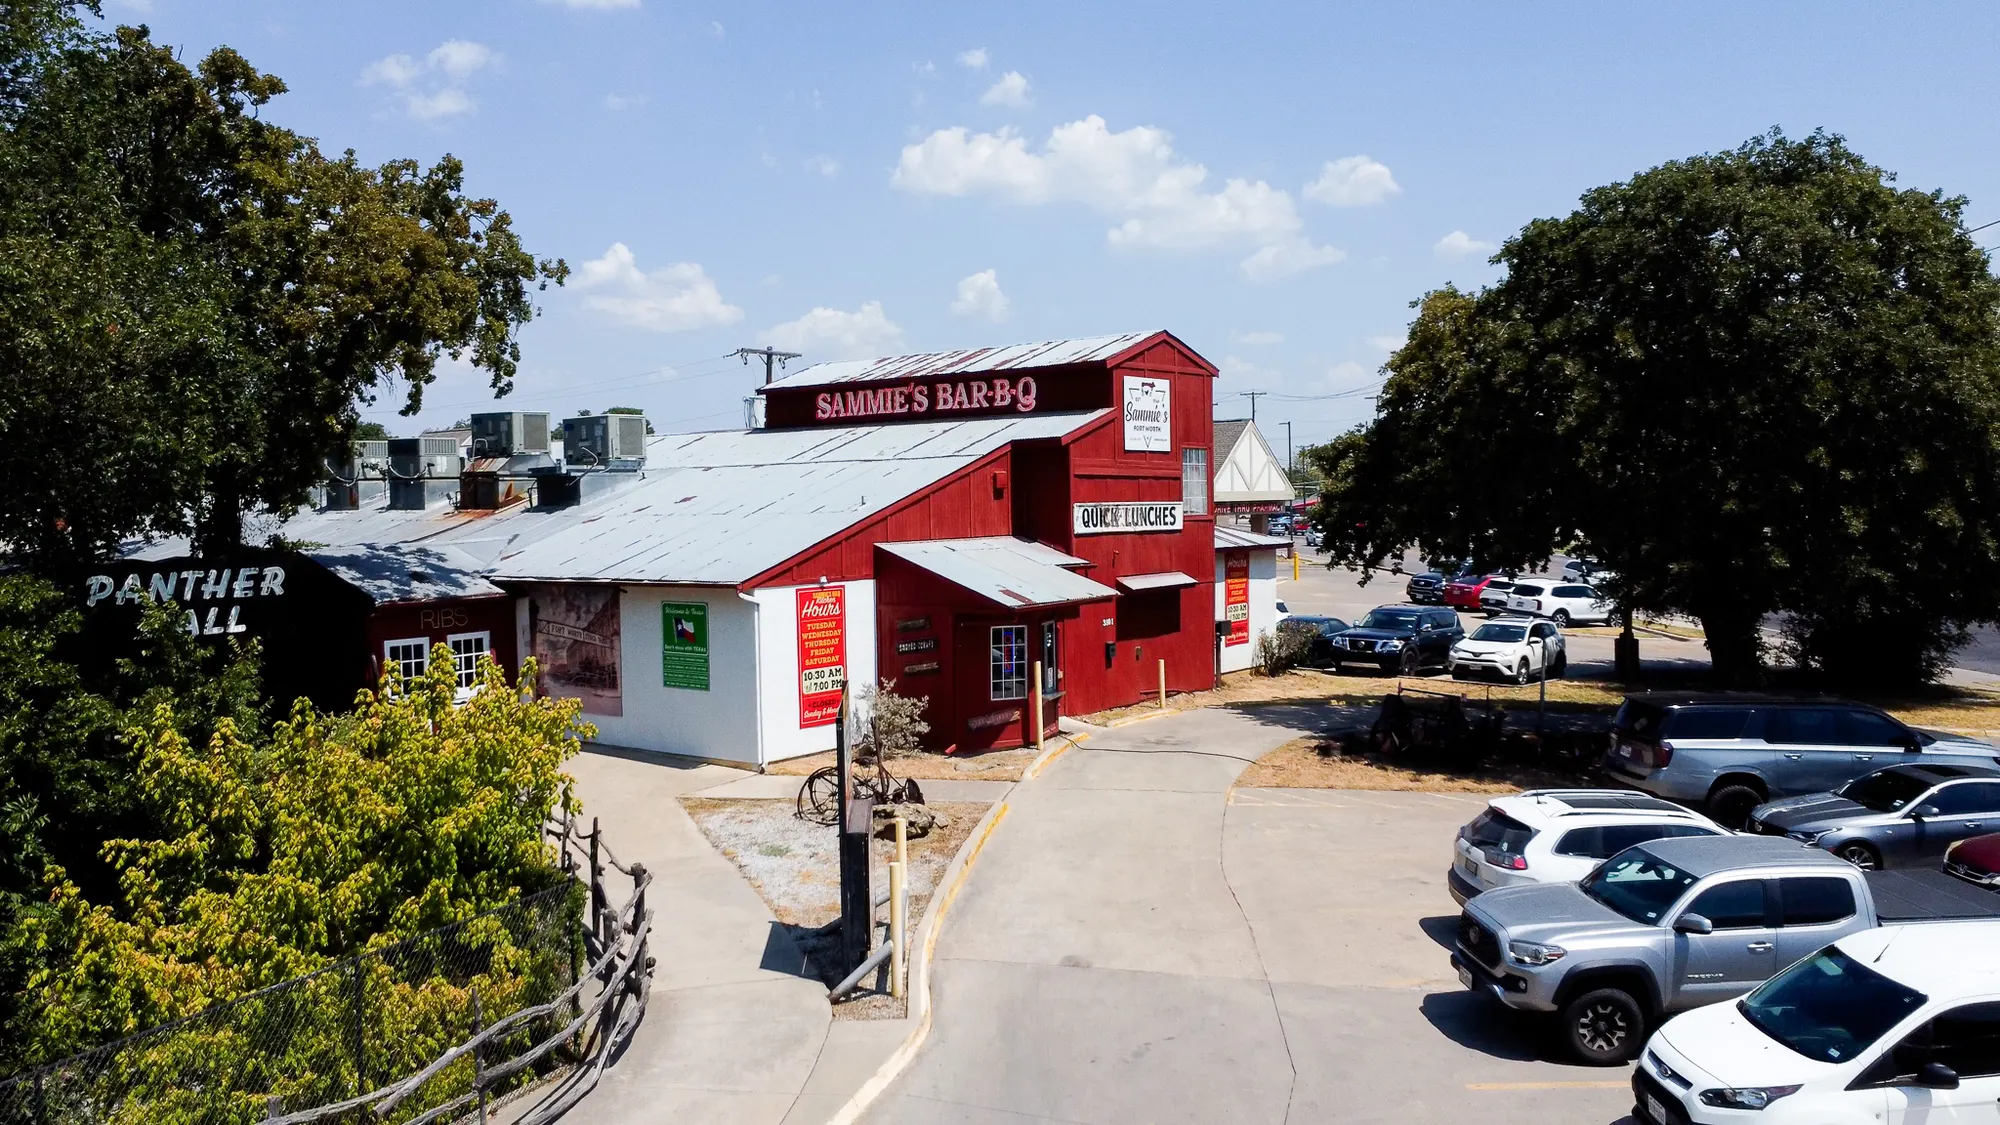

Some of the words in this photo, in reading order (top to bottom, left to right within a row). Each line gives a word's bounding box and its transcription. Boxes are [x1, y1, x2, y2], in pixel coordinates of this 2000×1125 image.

[815, 382, 928, 420] SAMMIE'S
[935, 376, 1036, 412] BAR-B-Q
[1125, 401, 1168, 424] Sammie's
[1082, 507, 1119, 529] QUICK
[1124, 506, 1177, 528] LUNCHES
[86, 566, 286, 608] PANTHER
[801, 599, 842, 619] Hours
[420, 607, 469, 630] RIBS
[806, 620, 837, 631] TUESDAY
[801, 629, 842, 641] WEDNESDAY
[804, 637, 840, 649] THURSDAY
[810, 646, 835, 657] FRIDAY
[804, 655, 840, 666] SATURDAY
[803, 669, 825, 682] 10:30
[828, 667, 842, 678] AM
[831, 679, 843, 689] PM
